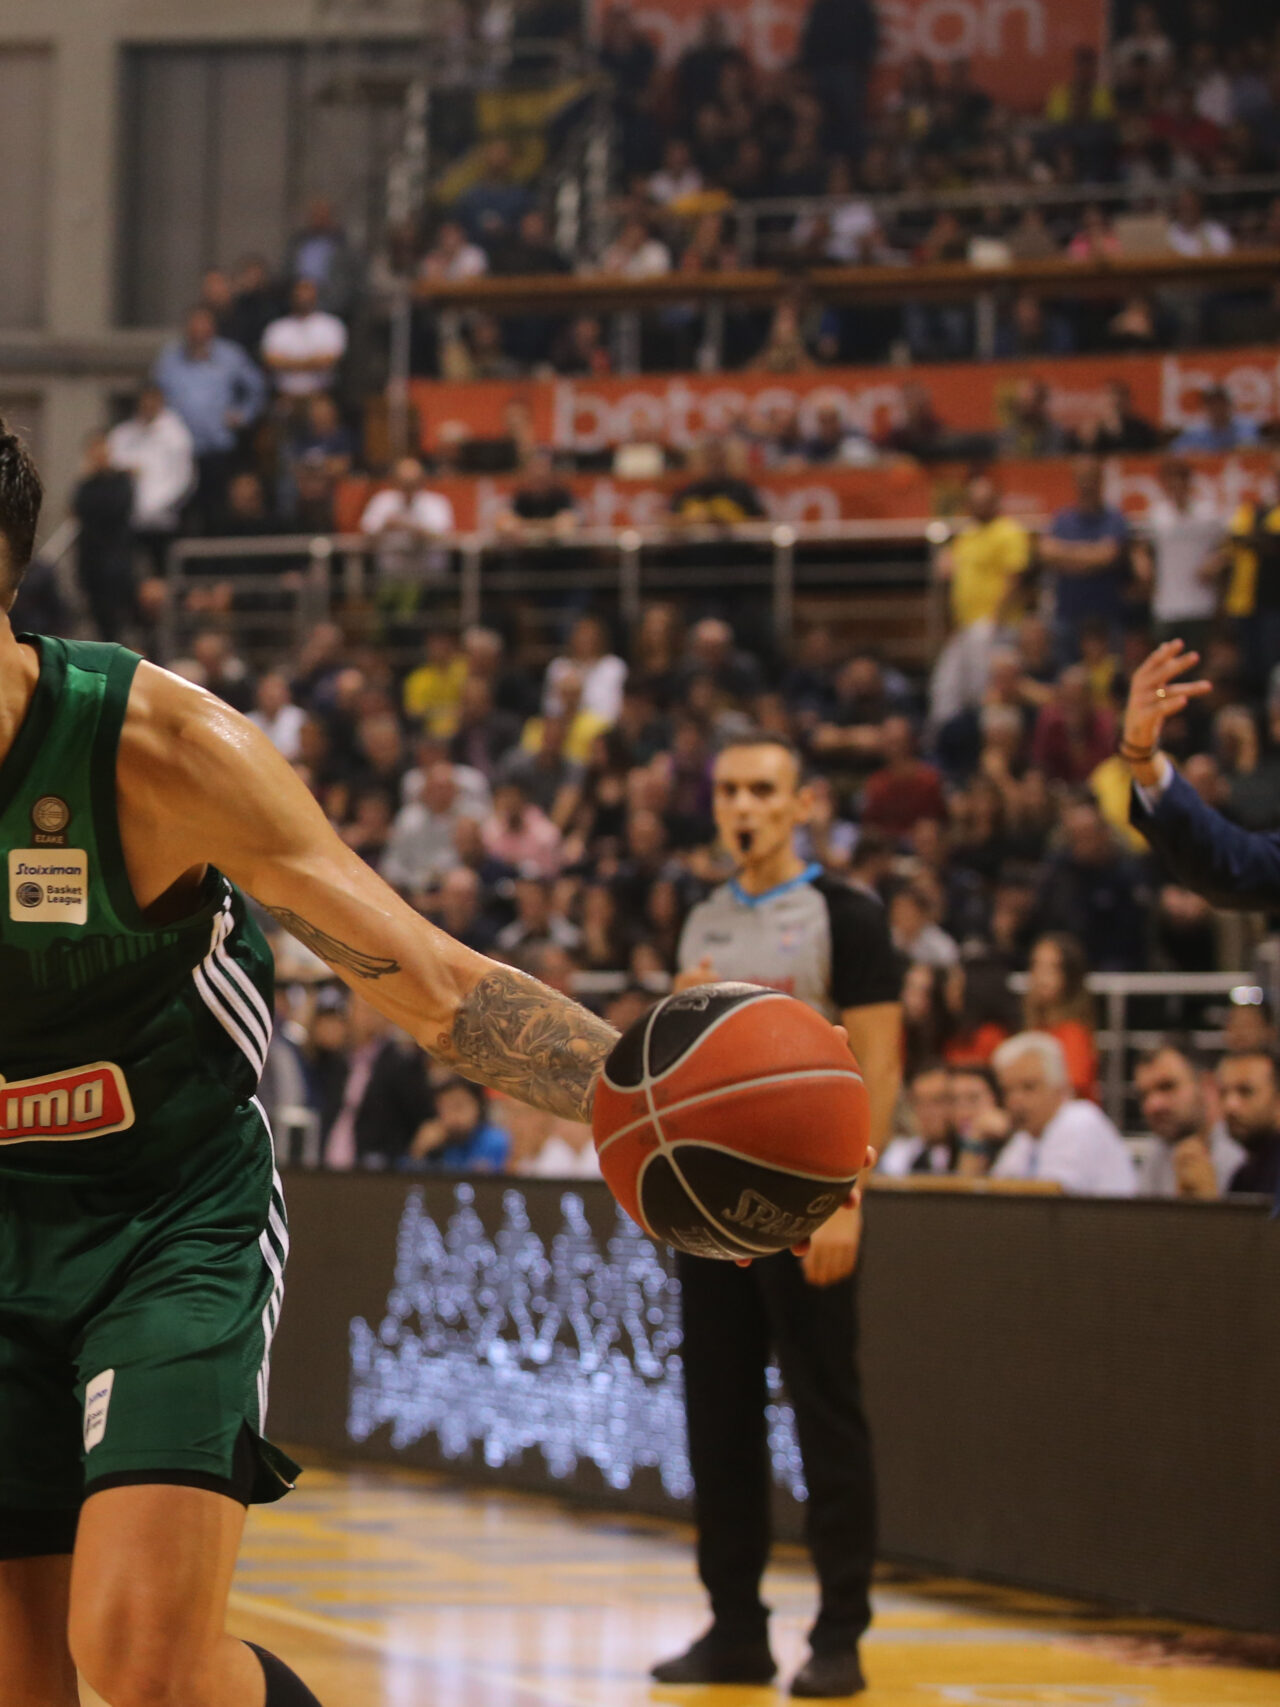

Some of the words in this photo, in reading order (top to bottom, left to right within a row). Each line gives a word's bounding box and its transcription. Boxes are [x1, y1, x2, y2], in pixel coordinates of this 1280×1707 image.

[16, 863, 83, 875] Stoiximan
[46, 884, 83, 896] Basket
[46, 895, 83, 906] League
